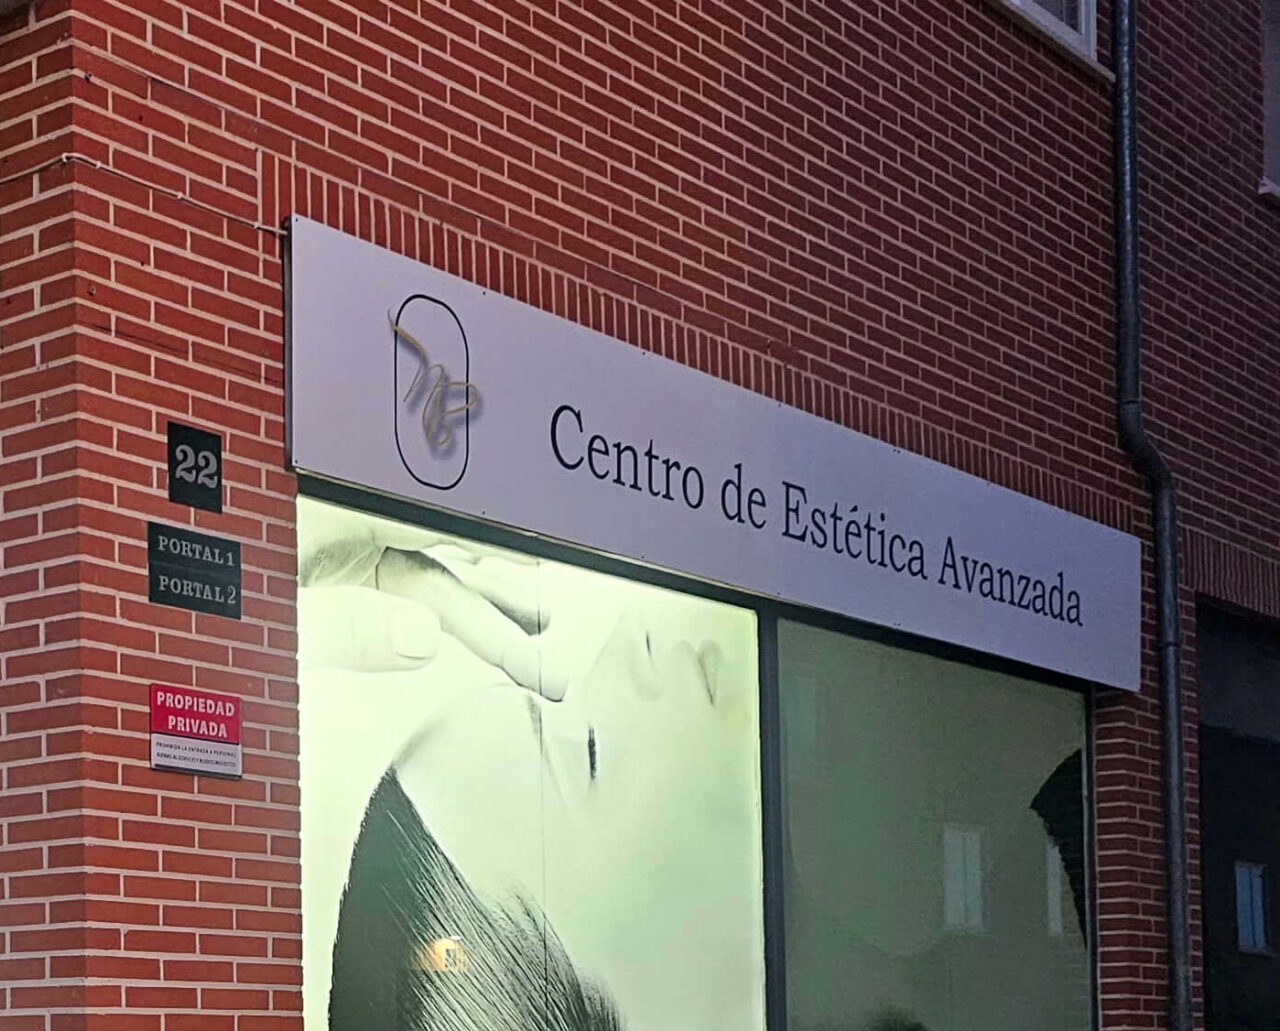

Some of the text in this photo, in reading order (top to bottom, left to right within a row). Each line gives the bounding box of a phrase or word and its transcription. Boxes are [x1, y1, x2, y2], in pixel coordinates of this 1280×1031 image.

[175, 444, 219, 489] 22
[549, 403, 1084, 628] Centro de Estética Avanzada
[158, 535, 234, 566] PORTAL 1
[158, 575, 236, 604] PORTAL 2
[156, 691, 235, 716] PROPIEDAD
[167, 714, 228, 738] PRIVADA
